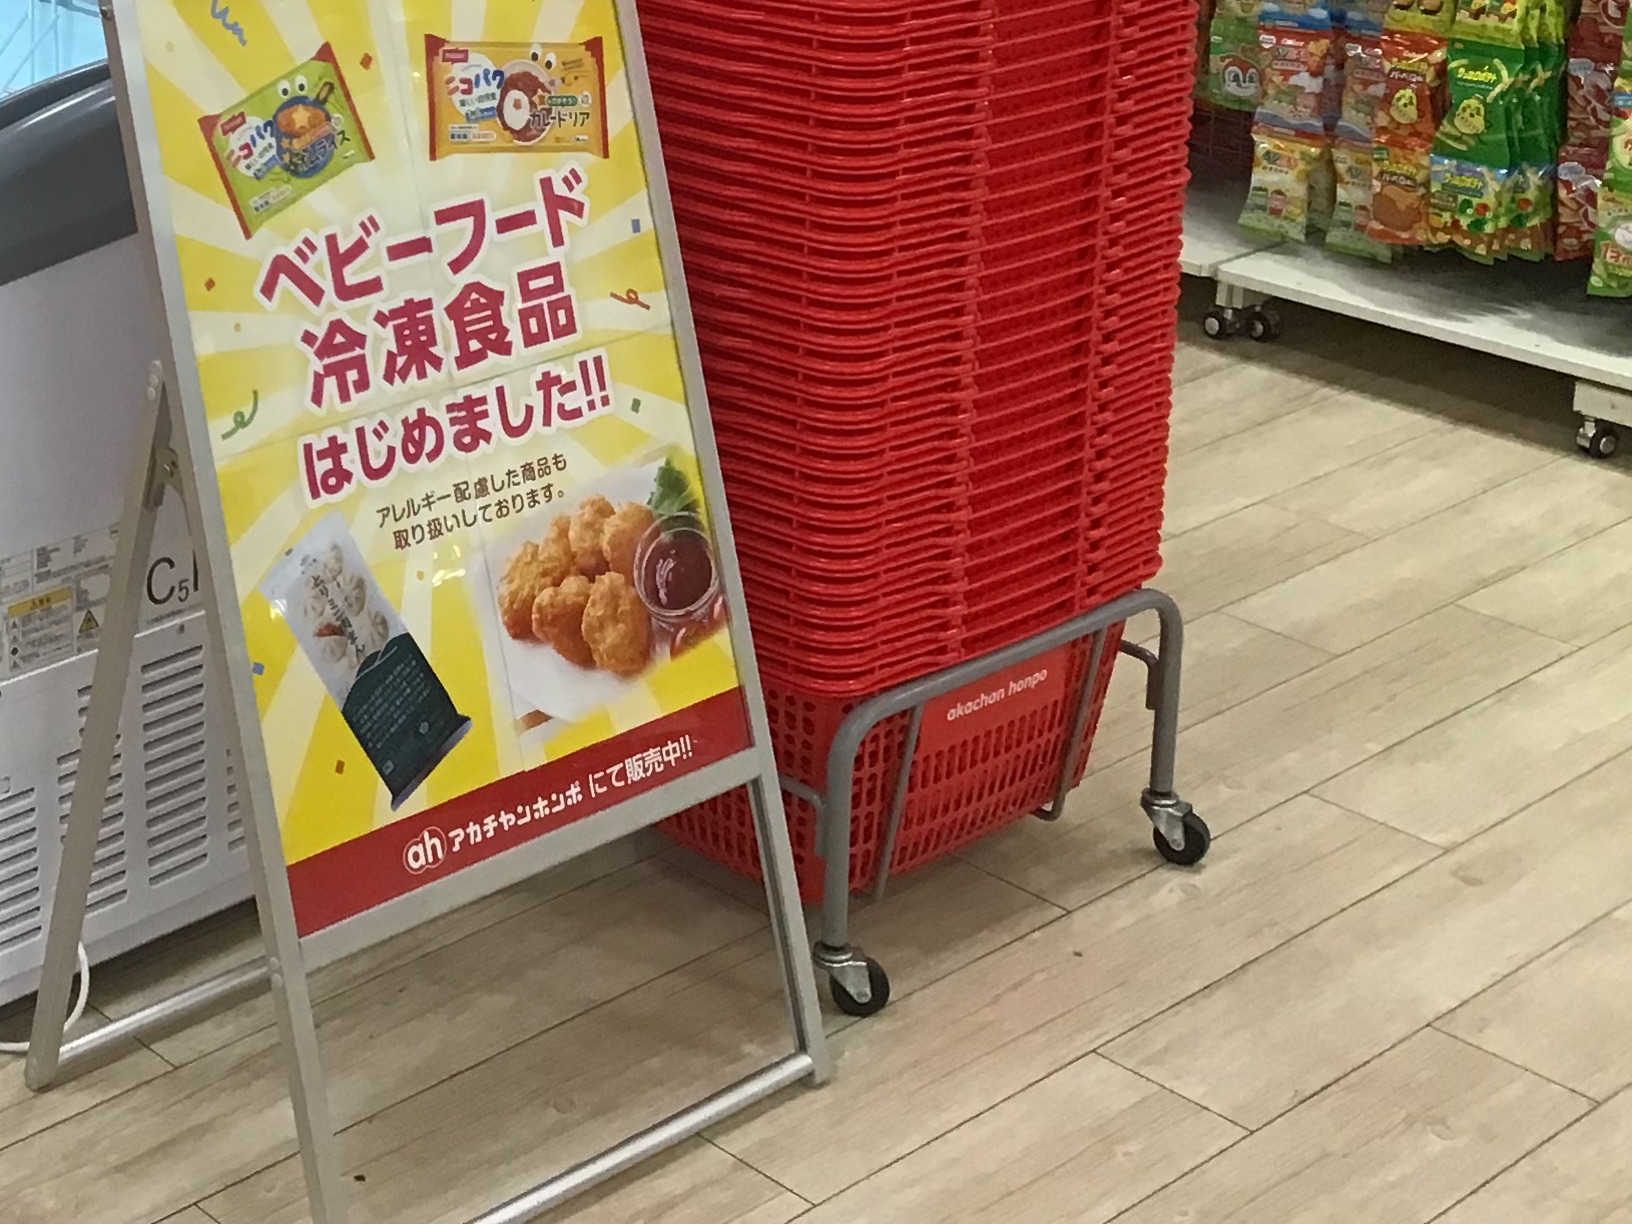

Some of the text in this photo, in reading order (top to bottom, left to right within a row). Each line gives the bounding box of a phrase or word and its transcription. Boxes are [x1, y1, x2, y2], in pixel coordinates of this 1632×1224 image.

[529, 111, 590, 128] カレードリア
[259, 167, 585, 307] ベビーフード
[300, 261, 577, 409] 冷凍食品
[303, 354, 610, 501] はじめました!!
[377, 453, 568, 529] アレルギー配慮した商品も
[393, 486, 566, 551] 取り扱いしております。
[946, 669, 1048, 721] akachan honpo
[406, 830, 444, 870] ah
[448, 780, 583, 852] アカチャンホンポ
